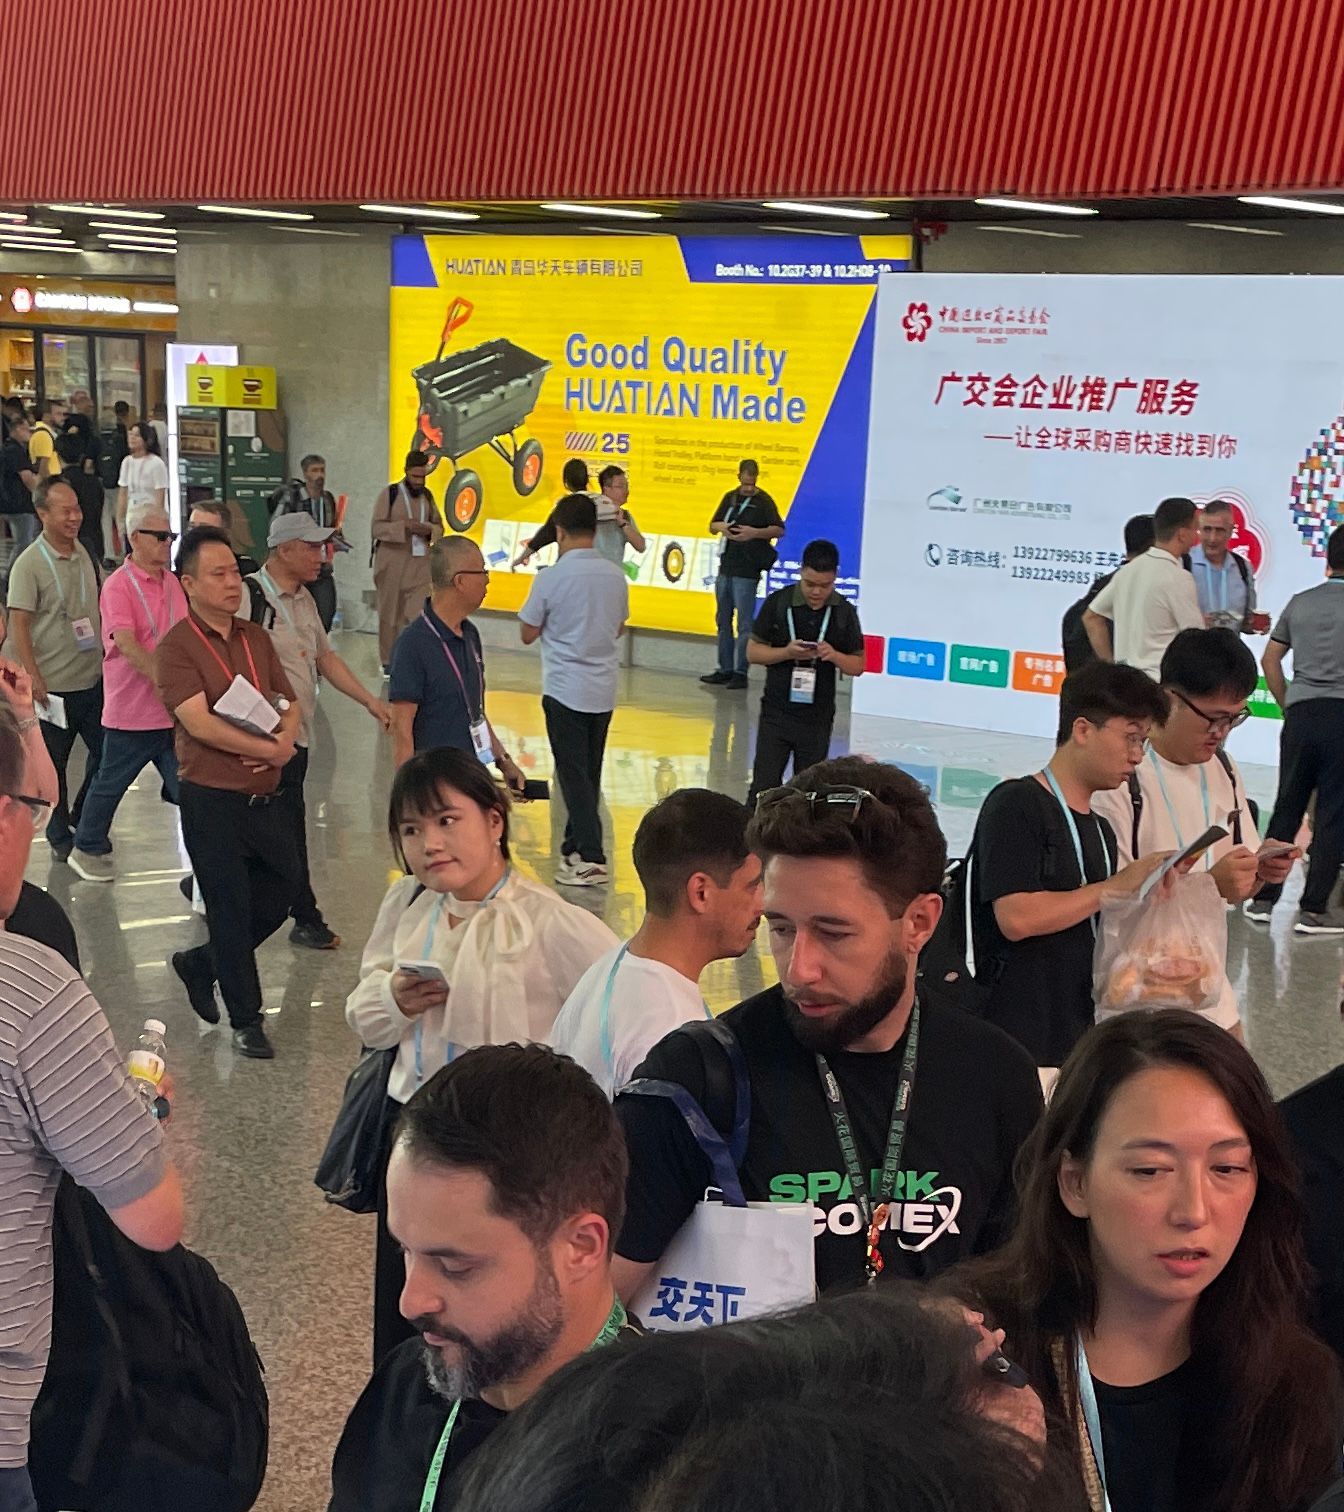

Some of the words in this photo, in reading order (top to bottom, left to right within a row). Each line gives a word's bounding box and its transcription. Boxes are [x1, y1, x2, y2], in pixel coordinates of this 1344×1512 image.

[446, 258, 506, 275] HUATIAN
[565, 333, 650, 369] Good
[663, 336, 788, 386] Quality
[564, 377, 700, 418] HUATIAN
[712, 383, 807, 424] Made
[934, 371, 1200, 416] 广交会企业推广服务
[602, 432, 631, 454] 25
[1012, 546, 1093, 565] 13922799636
[1011, 566, 1090, 585] 13922249985
